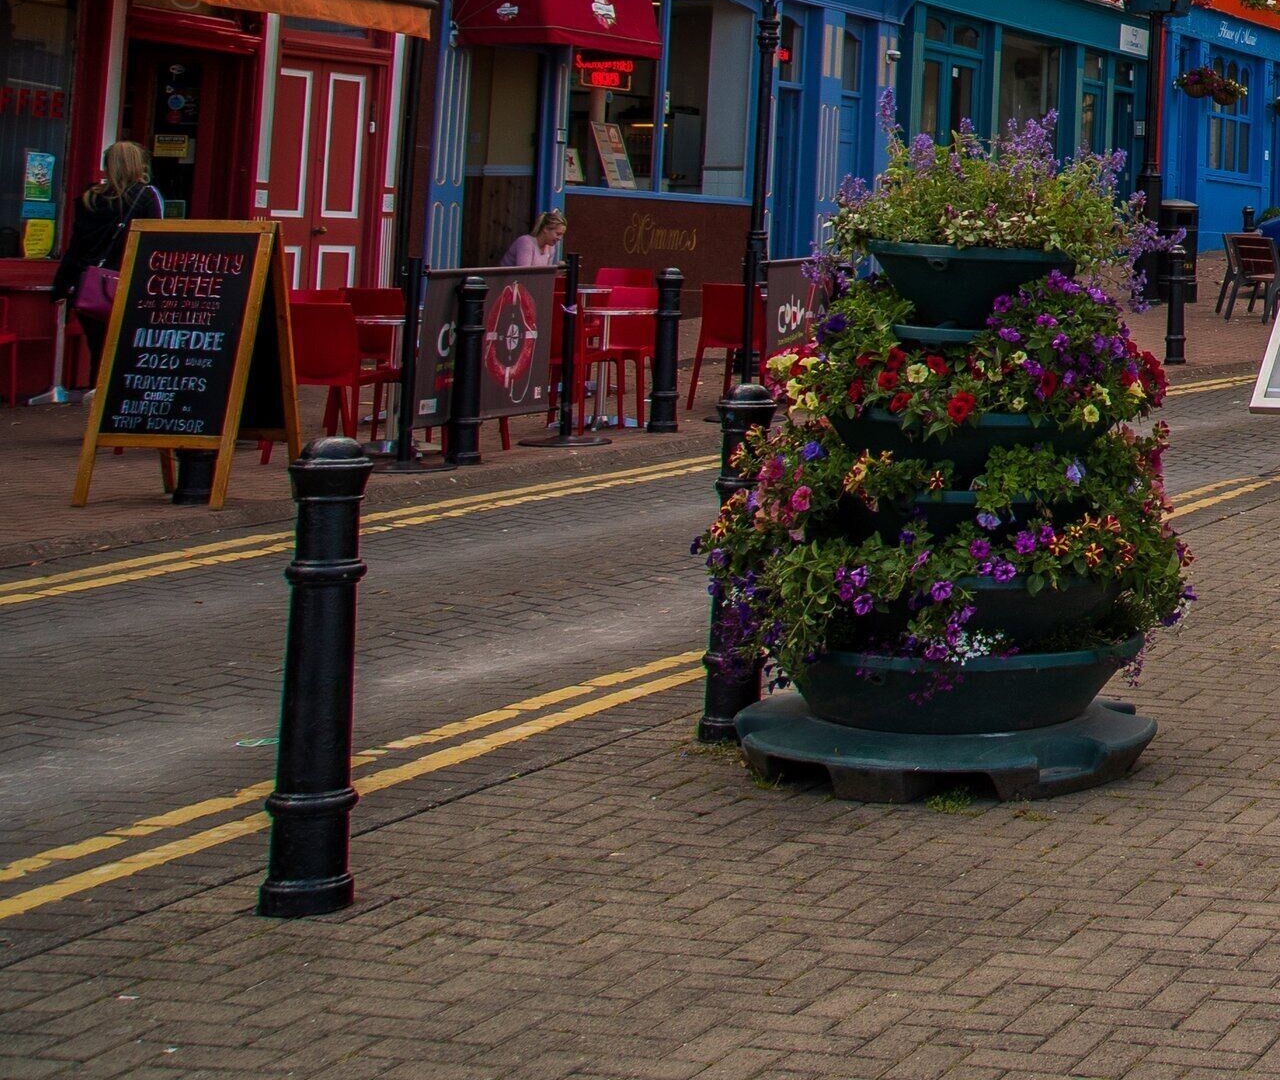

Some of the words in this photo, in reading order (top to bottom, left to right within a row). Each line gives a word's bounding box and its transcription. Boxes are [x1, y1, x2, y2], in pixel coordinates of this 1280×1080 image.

[147, 274, 224, 299] COFFEE
[150, 311, 216, 326] EXCELLENT
[133, 327, 226, 351] AWARDEE
[136, 353, 180, 370] 2020
[123, 374, 208, 392] TRAVELLERS
[144, 391, 176, 402] CHOICE
[121, 400, 171, 416] AWARD
[112, 415, 142, 429] TRIP
[147, 417, 205, 434] ADVISOR
